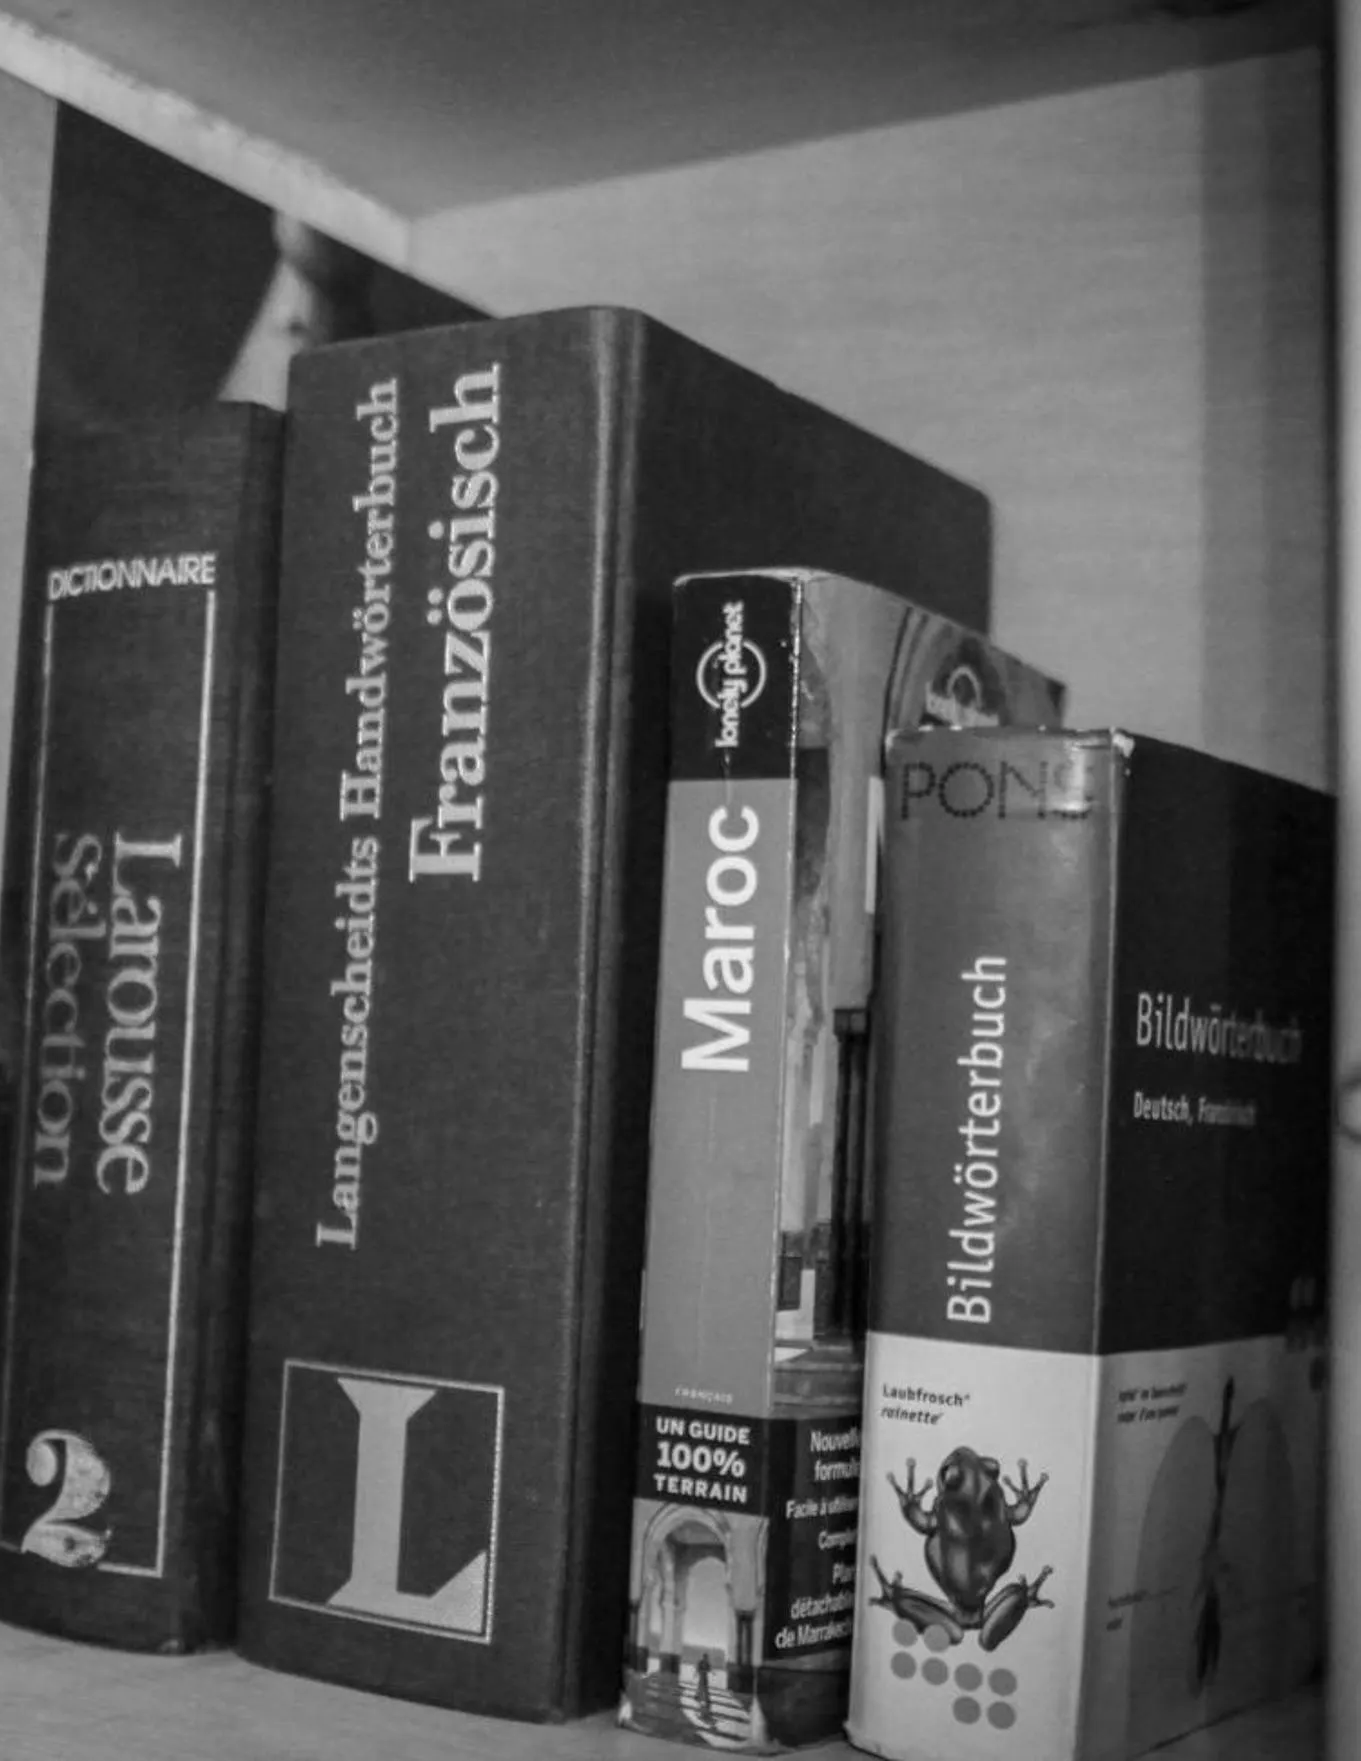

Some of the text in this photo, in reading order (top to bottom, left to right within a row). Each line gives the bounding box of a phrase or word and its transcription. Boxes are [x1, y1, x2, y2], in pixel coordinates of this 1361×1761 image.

[48, 552, 218, 599] DICTIONNAIRE
[408, 362, 501, 882] Französisch
[714, 600, 748, 747] lonely planet
[315, 376, 398, 1250] Langenscheidts Handwörterbuch
[34, 832, 107, 1188] Sélection
[95, 831, 182, 1195] Larousse
[681, 805, 760, 1072] Maroc
[947, 955, 1008, 1324] Bildwörterbuch
[21, 1429, 111, 1567] 2
[325, 1377, 488, 1636] L
[653, 1472, 747, 1504] TERRAIN
[656, 1416, 751, 1445] UN GUIDE
[657, 1441, 746, 1478] 100%
[775, 1627, 796, 1649] de
